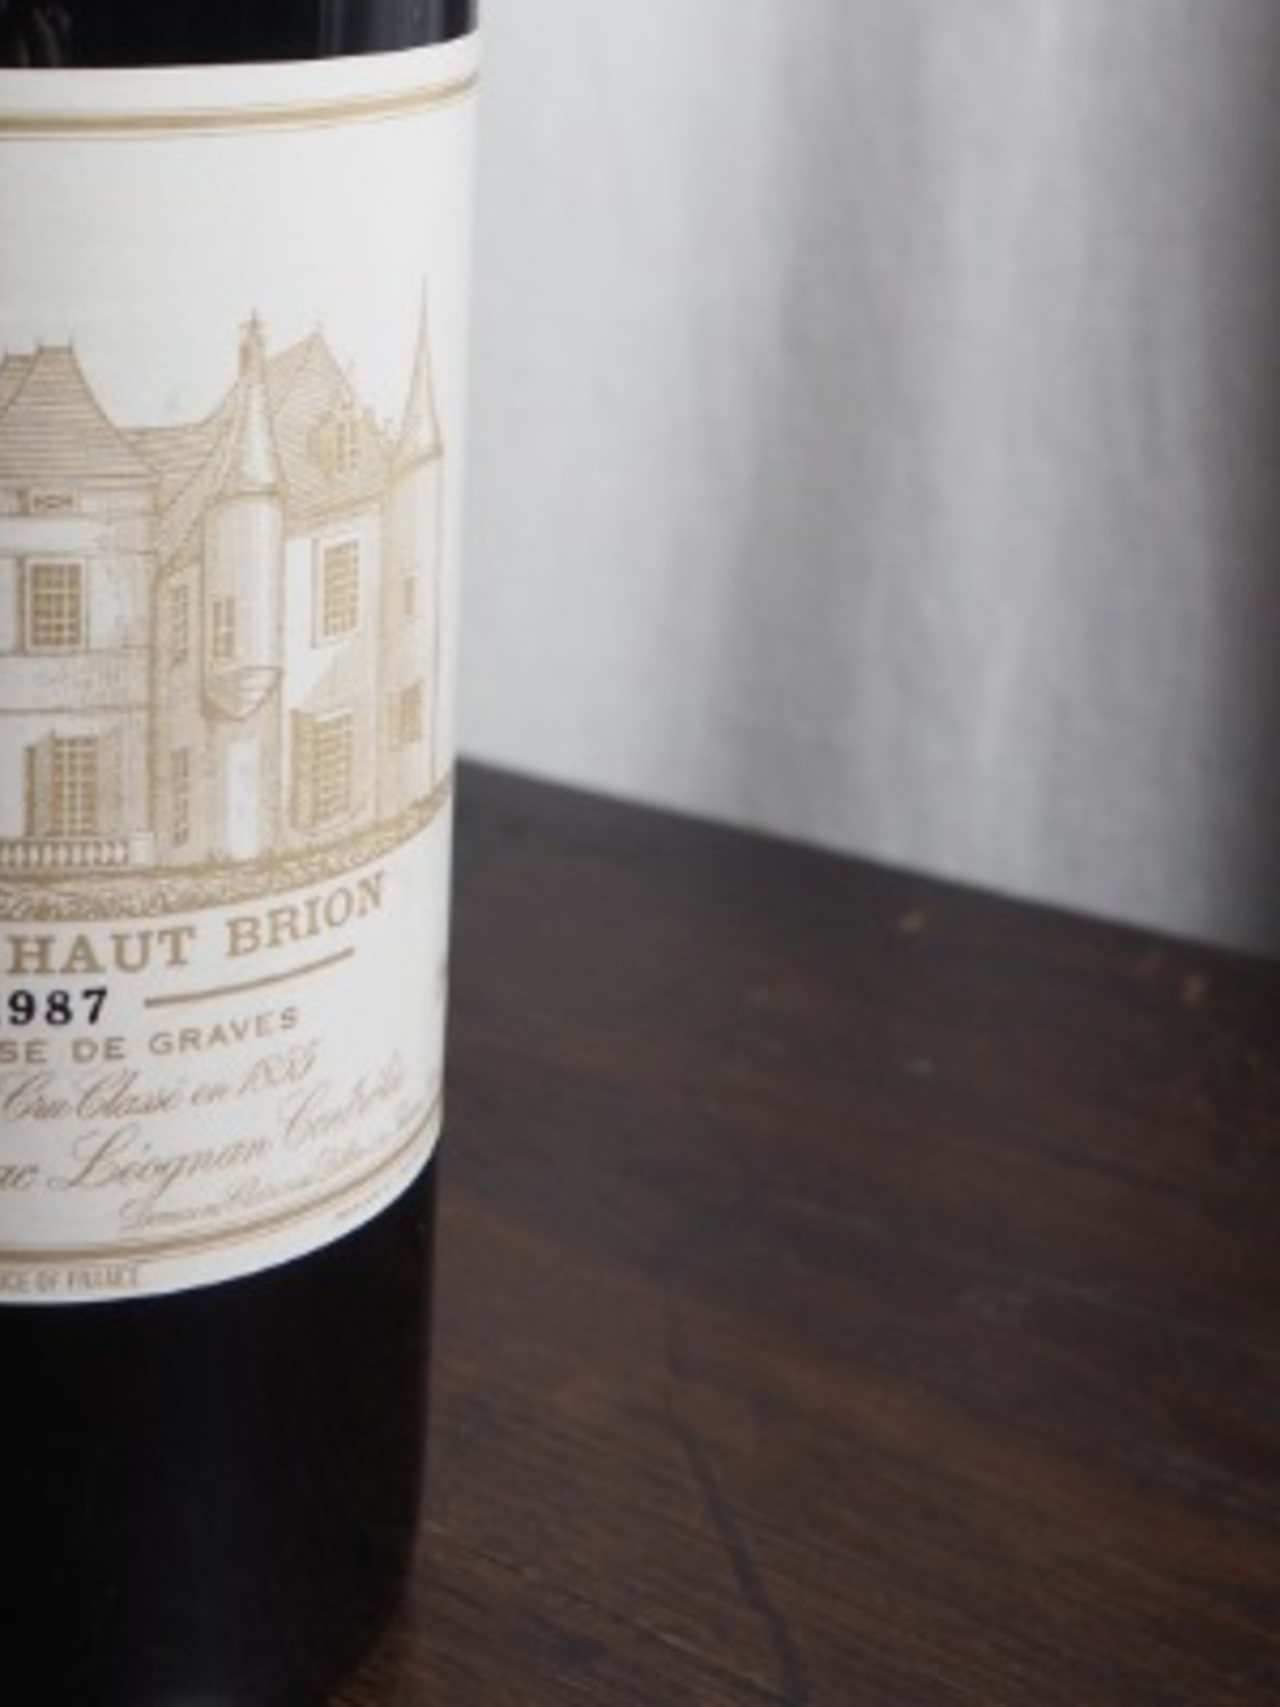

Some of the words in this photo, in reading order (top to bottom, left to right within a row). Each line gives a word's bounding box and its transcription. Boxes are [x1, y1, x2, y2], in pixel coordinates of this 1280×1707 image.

[6, 925, 196, 975] HAUT
[226, 870, 387, 957] BRION
[72, 1037, 125, 1064] DE
[149, 1007, 299, 1056] GRAVES
[3, 1069, 70, 1121] Cru
[191, 1081, 229, 1106] en
